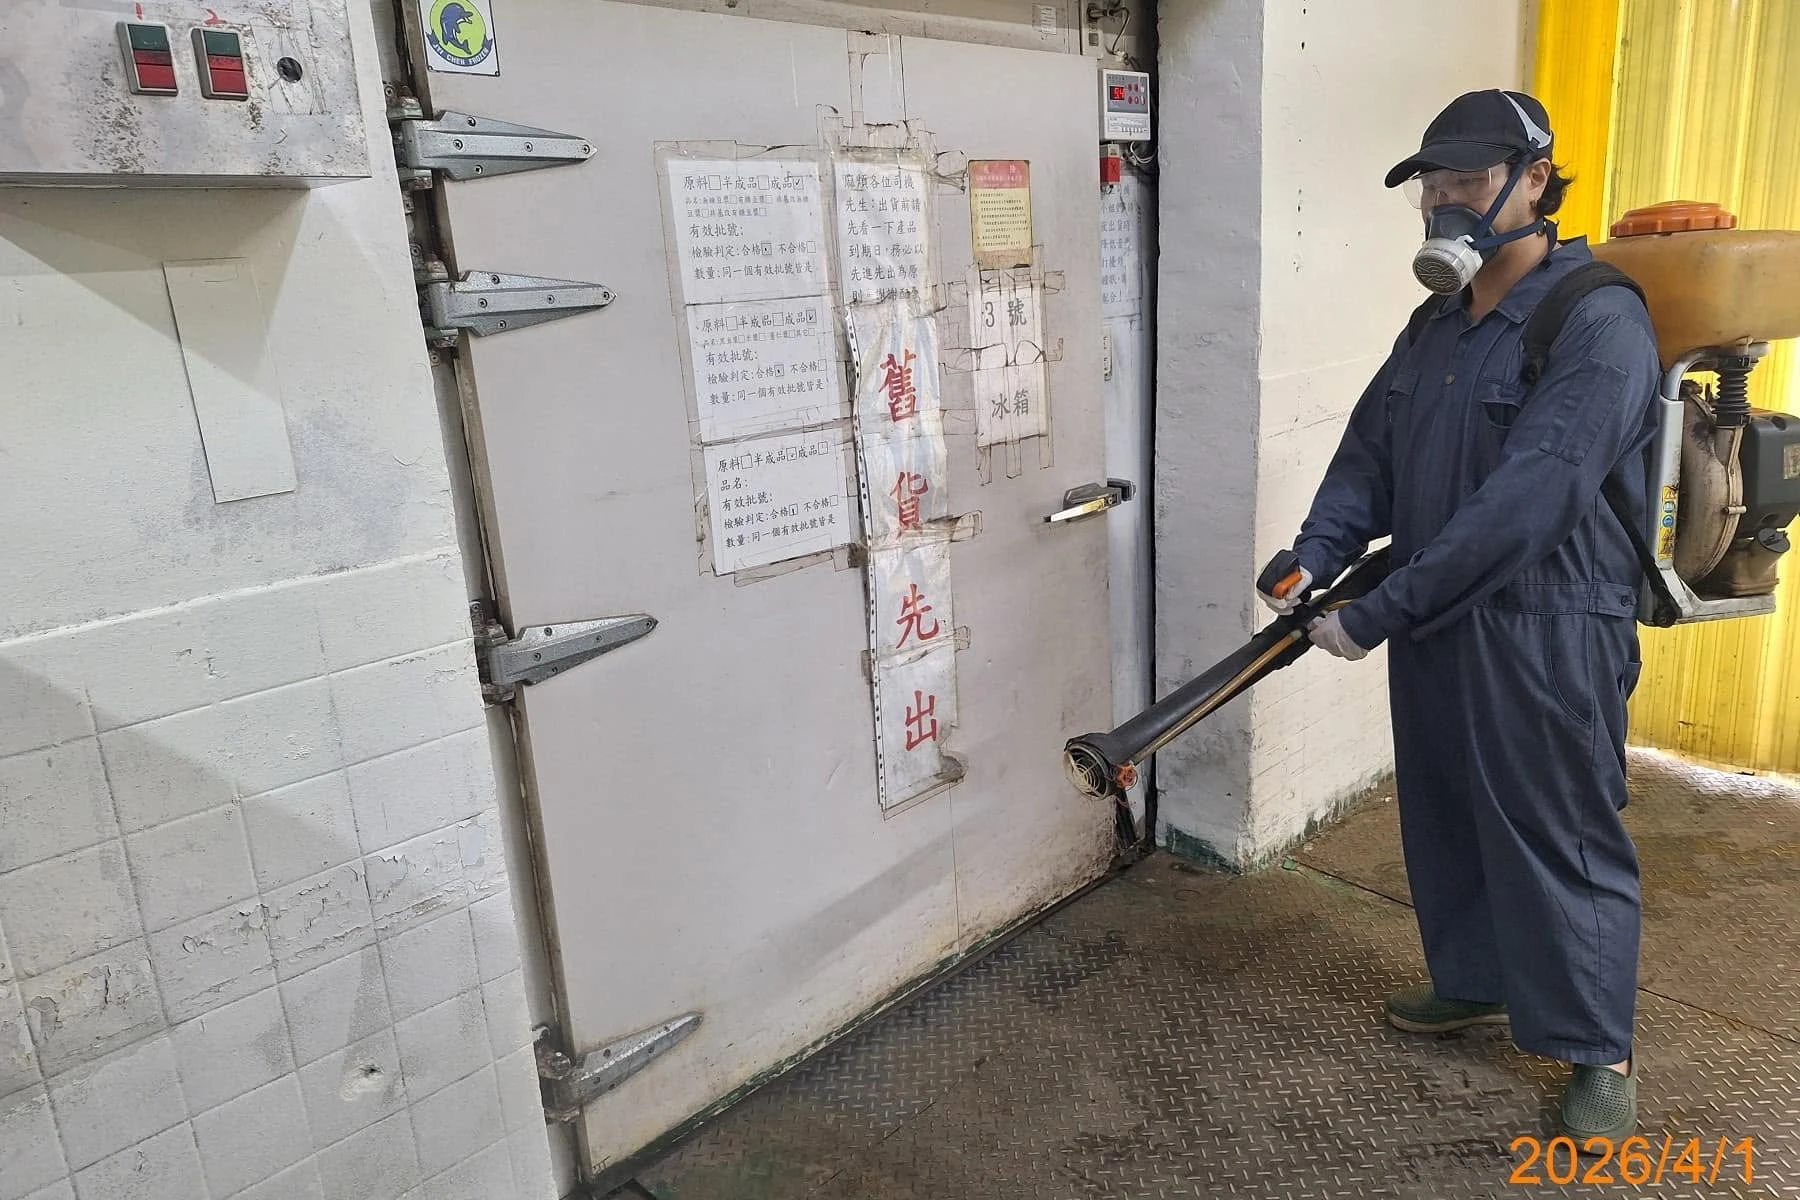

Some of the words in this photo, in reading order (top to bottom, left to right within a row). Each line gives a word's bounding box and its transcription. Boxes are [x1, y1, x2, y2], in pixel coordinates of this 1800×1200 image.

[689, 223, 744, 239] 有效批號:
[847, 219, 917, 236] 先看一下產品
[851, 264, 918, 281] 先進先出為原
[784, 312, 806, 326] 成品
[706, 348, 758, 366] 有效批號:
[791, 361, 818, 374] 不合格
[991, 389, 1029, 420] 冰箱
[718, 458, 741, 473] 原料
[753, 451, 786, 467] 半成品
[798, 446, 818, 459] 成品
[720, 477, 749, 491] 品名:
[722, 492, 773, 511] 有效批號:
[803, 498, 831, 512] 不合格
[726, 514, 836, 548] 數量:同一個有效批號皆是
